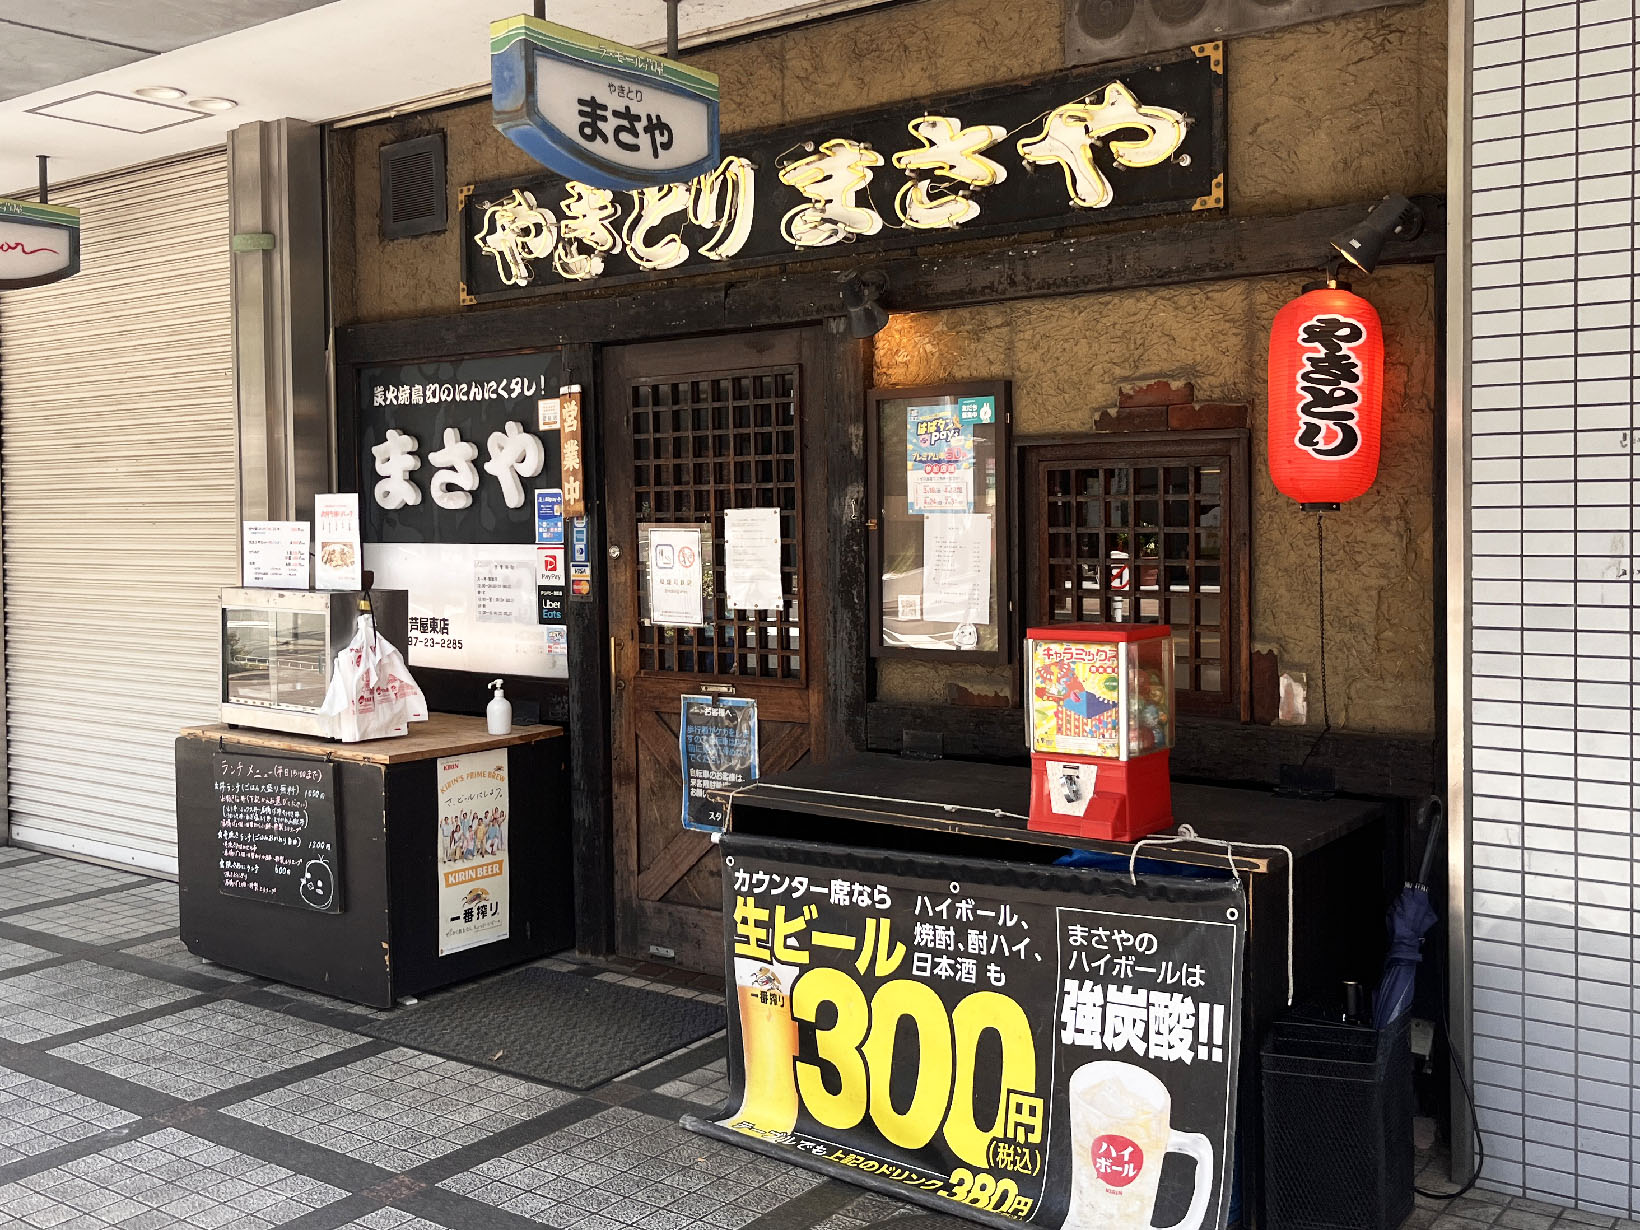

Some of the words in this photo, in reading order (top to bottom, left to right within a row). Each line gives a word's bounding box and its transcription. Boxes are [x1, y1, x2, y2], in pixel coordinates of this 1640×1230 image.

[607, 81, 643, 103] やきとり
[577, 95, 674, 159] まさや
[778, 80, 1190, 250] まさや
[1296, 315, 1367, 459] やきとり
[371, 420, 545, 511] まさや
[562, 399, 581, 506] 営業中
[541, 573, 561, 581] PayPay
[574, 567, 587, 575] VISA
[542, 599, 561, 609] Uber
[542, 608, 562, 619] Eats
[408, 616, 450, 636] 芦屋東店
[443, 763, 459, 771] KIRIN
[448, 869, 476, 885] KIRIN
[477, 863, 500, 878] BEER
[734, 868, 892, 910] カウンター席なら
[450, 901, 499, 924] 一番搾り
[914, 894, 1029, 930] ハイボール、
[733, 894, 908, 978] 生ビール
[913, 921, 1043, 962] 焼酎、酎ハイ、
[1067, 923, 1158, 955] まさやの
[911, 951, 978, 984] 日本酒
[986, 962, 1007, 987] も
[1068, 950, 1206, 988] ハイボールは
[750, 991, 786, 1008] 一番搾り
[1060, 978, 1225, 1066] 強炭酸!!
[988, 1140, 1042, 1177] (税込)
[1095, 1156, 1138, 1178] ボール
[1098, 1141, 1135, 1162] ハイ
